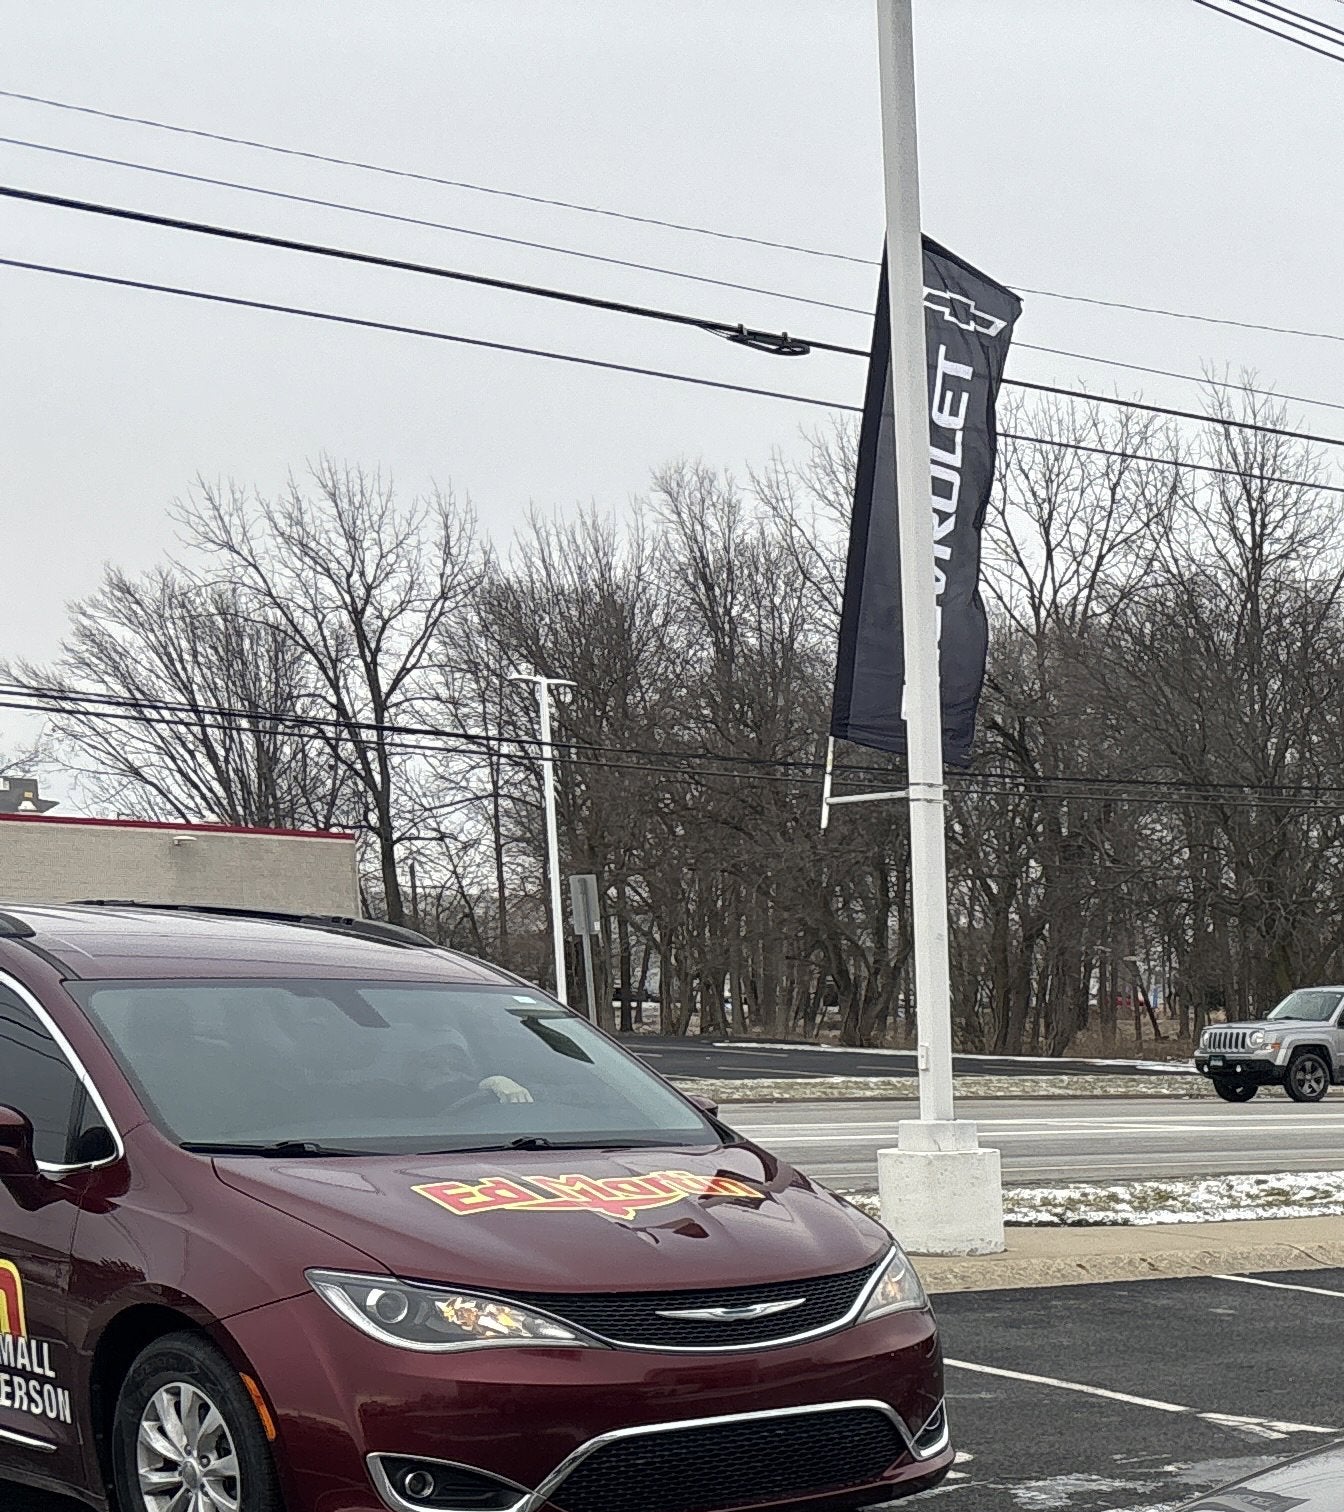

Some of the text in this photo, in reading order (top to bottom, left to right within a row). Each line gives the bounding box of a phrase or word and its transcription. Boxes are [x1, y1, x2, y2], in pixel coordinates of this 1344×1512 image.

[411, 1170, 766, 1215] Ed Martin
[0, 1334, 56, 1378] MALL
